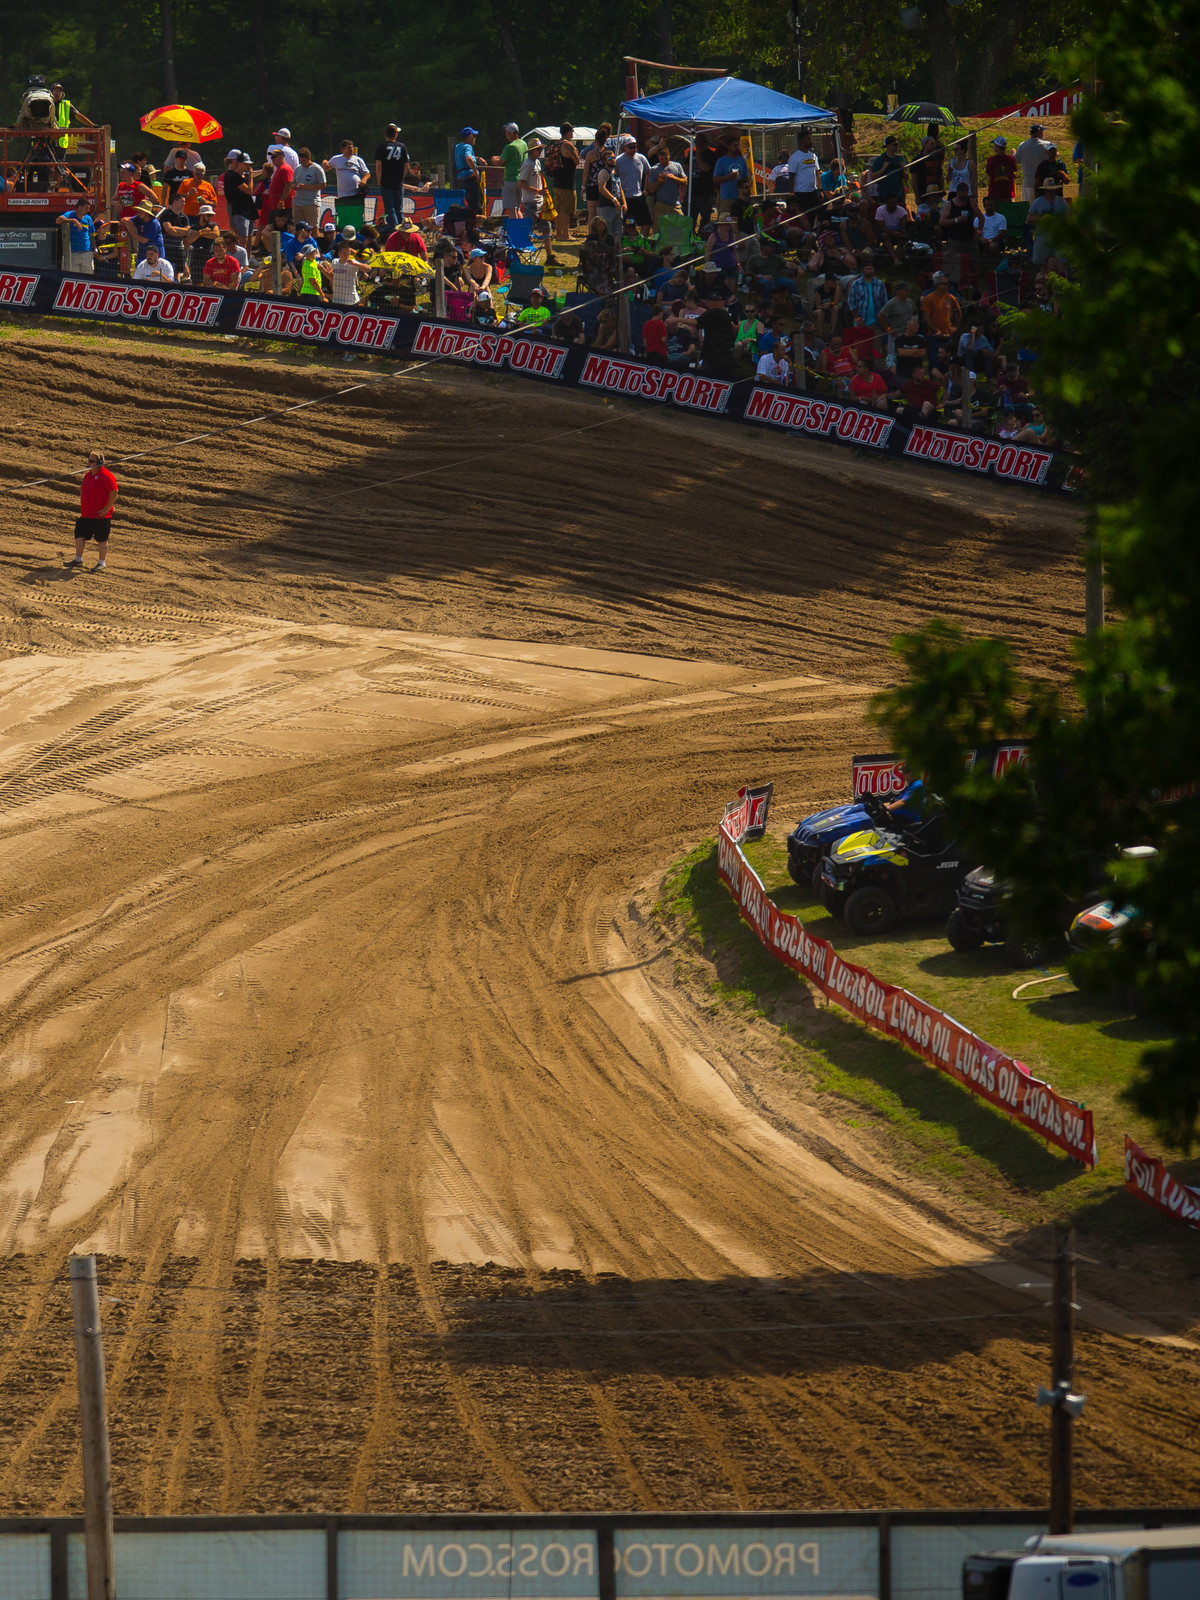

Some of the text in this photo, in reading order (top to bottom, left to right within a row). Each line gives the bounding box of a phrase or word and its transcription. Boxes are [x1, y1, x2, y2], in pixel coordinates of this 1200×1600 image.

[386, 146, 402, 160] 74
[936, 860, 960, 869] JGR
[773, 917, 812, 968] LUCAS
[827, 955, 885, 1021] LUCAS OIL
[890, 995, 951, 1062] LUCAS OIL
[955, 1037, 1019, 1107] LUCAS OIL
[1023, 1083, 1086, 1150] LUCAS OIL
[1132, 1158, 1156, 1198] OIL
